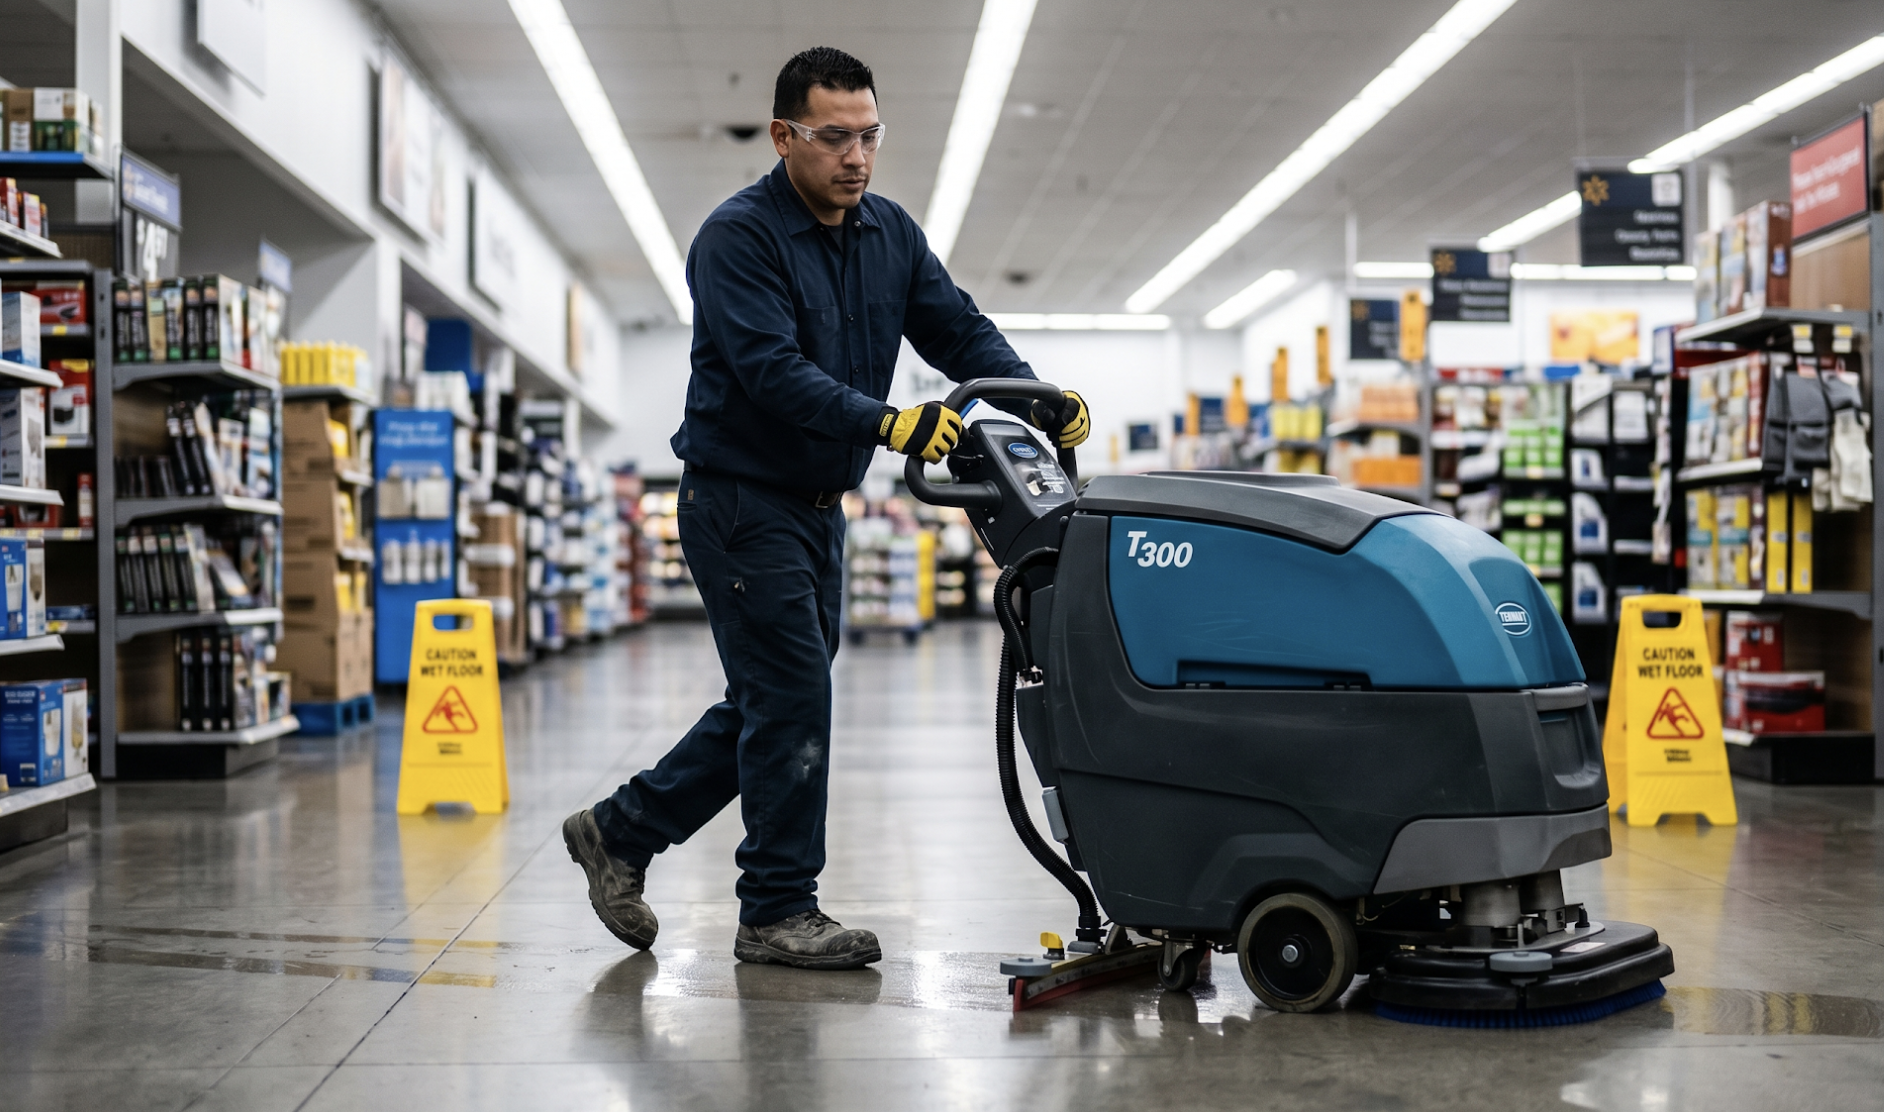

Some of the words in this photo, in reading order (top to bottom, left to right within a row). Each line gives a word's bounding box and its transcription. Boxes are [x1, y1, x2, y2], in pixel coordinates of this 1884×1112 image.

[1127, 531, 1193, 568] T300
[426, 648, 477, 661] CAUTION
[1642, 647, 1696, 661] CAUTION
[420, 665, 443, 677] WET
[447, 665, 484, 677] FLOOR
[1637, 665, 1662, 678] WET
[1665, 665, 1704, 678] FLOOR
